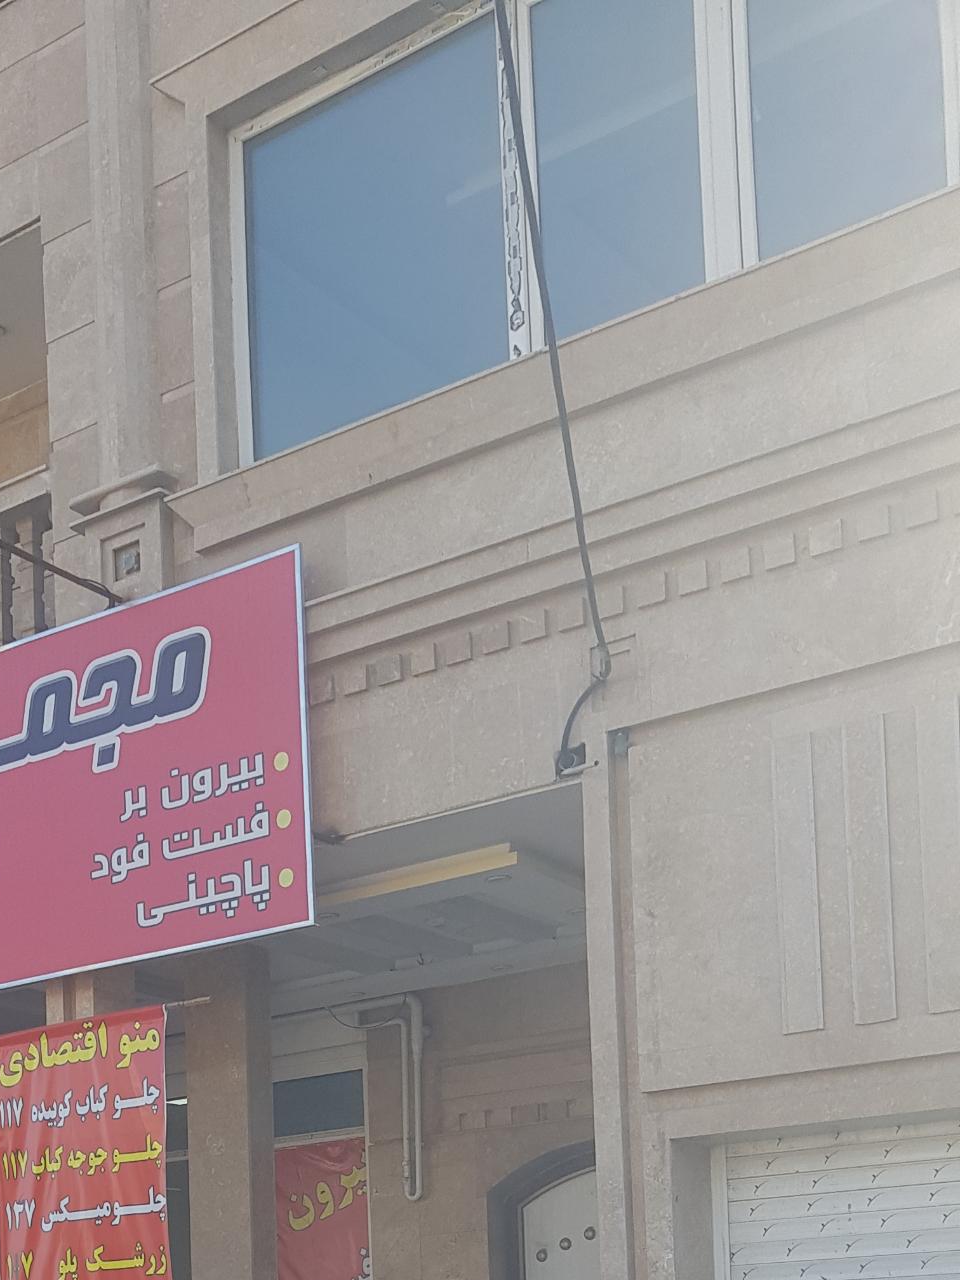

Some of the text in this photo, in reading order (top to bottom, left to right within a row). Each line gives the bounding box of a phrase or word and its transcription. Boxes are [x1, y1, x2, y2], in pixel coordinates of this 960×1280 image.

[119, 752, 265, 822] بیرون بر
[90, 801, 271, 884] فست فود
[135, 858, 271, 928] پاچینی
[116, 1021, 161, 1069] منو
[0, 1076, 161, 1129] چلو کباب کوبیده ۱۱۷
[31, 1145, 64, 1181] کباب
[67, 1147, 108, 1176] جوجه
[111, 1133, 163, 1173] چلو
[85, 1241, 168, 1277] زرشک
